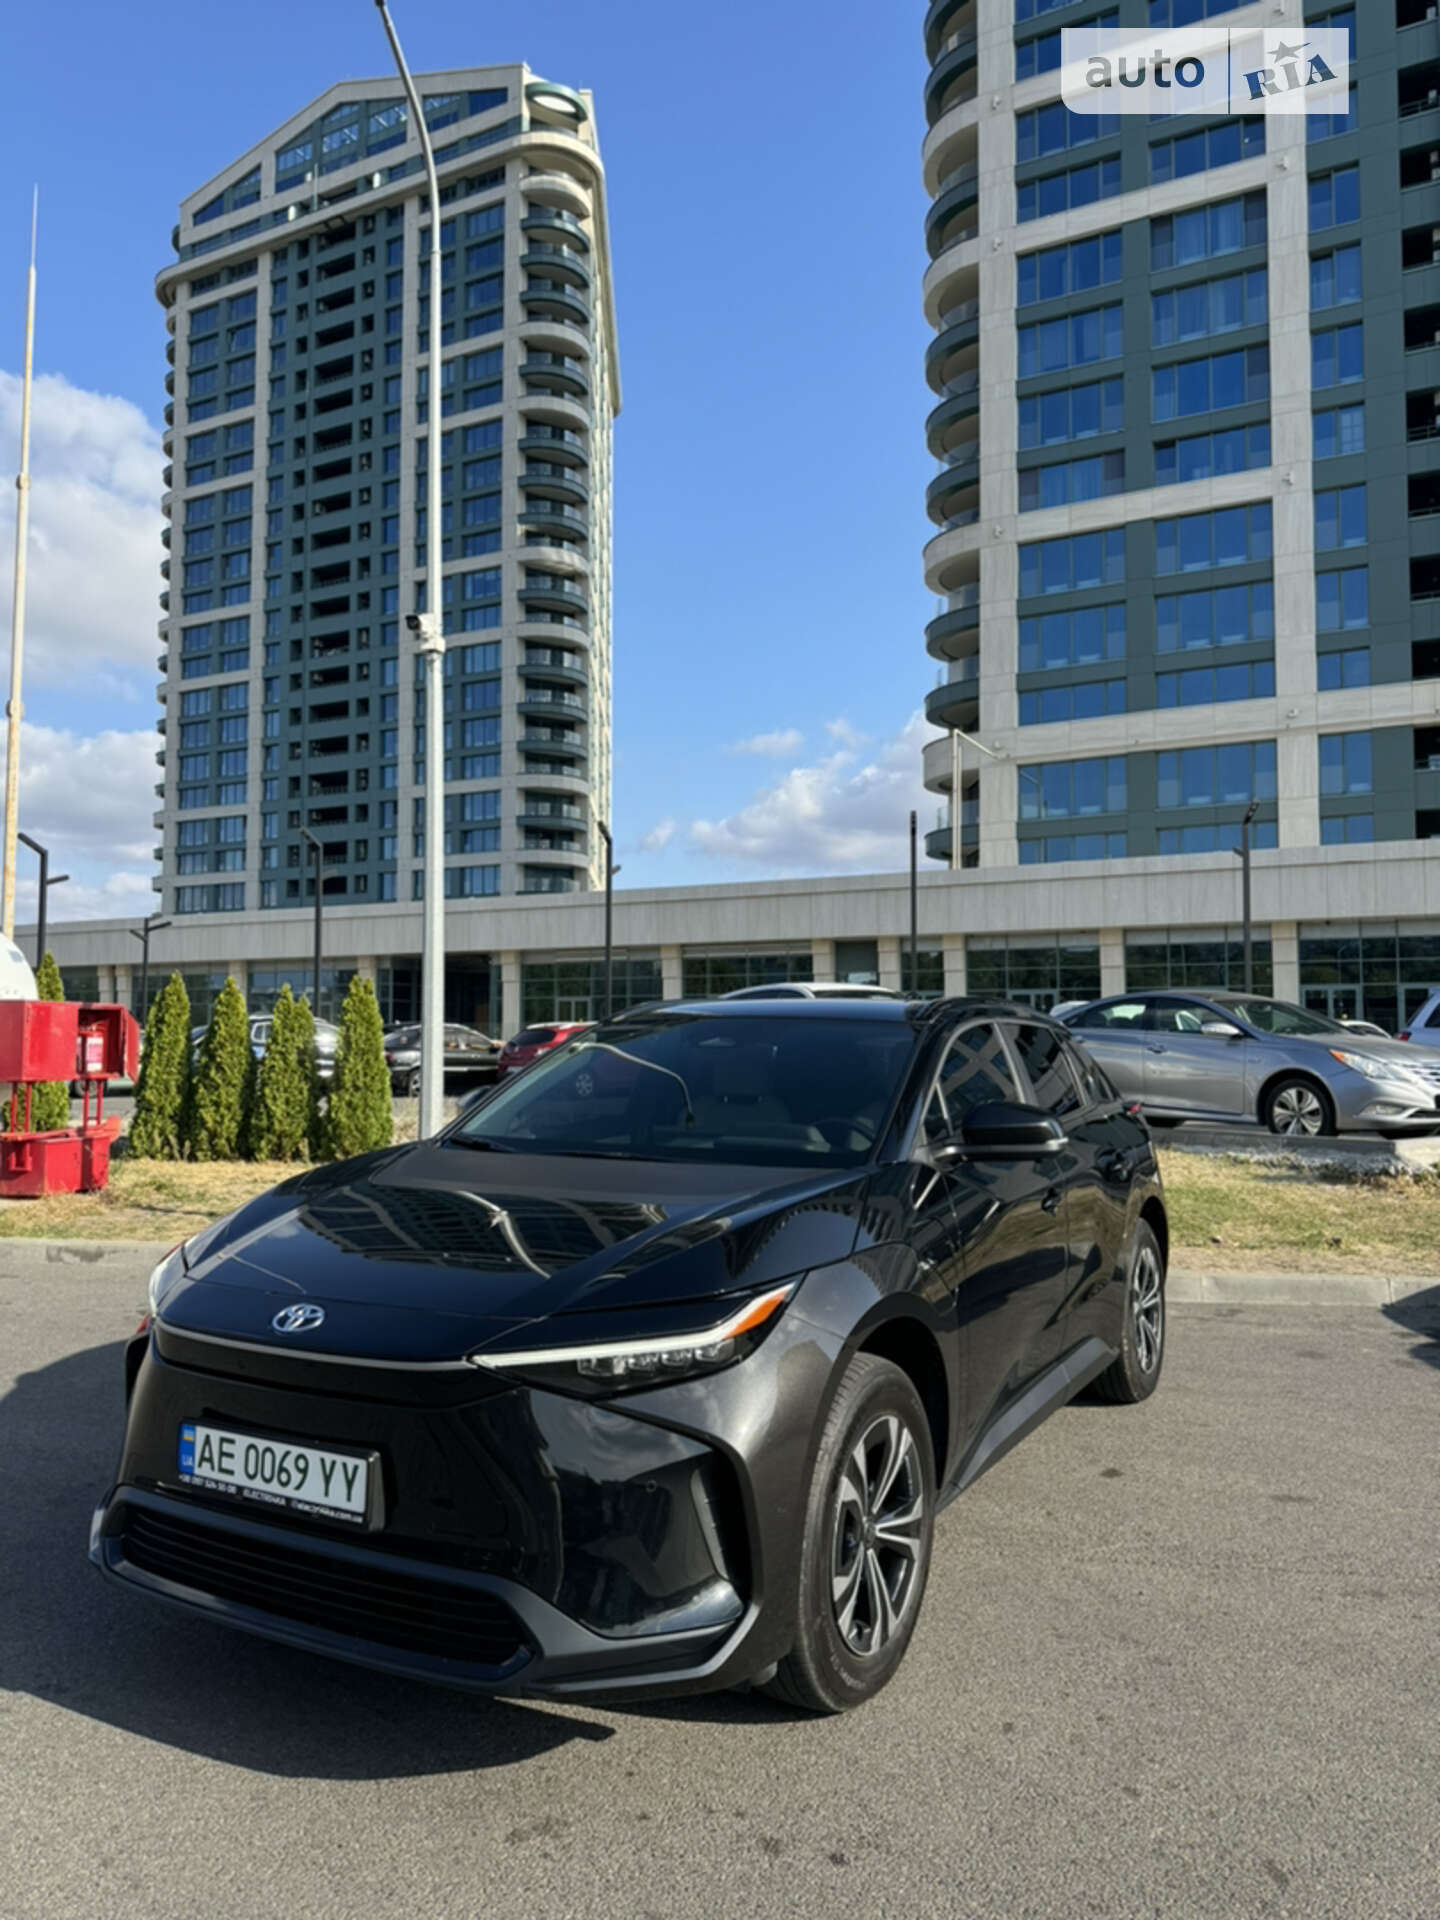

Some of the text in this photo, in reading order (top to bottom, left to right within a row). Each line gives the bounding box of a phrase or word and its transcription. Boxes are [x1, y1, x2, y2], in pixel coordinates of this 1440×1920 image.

[198, 1433, 236, 1476] AE
[244, 1443, 310, 1491] 0069
[320, 1457, 359, 1503] YY
